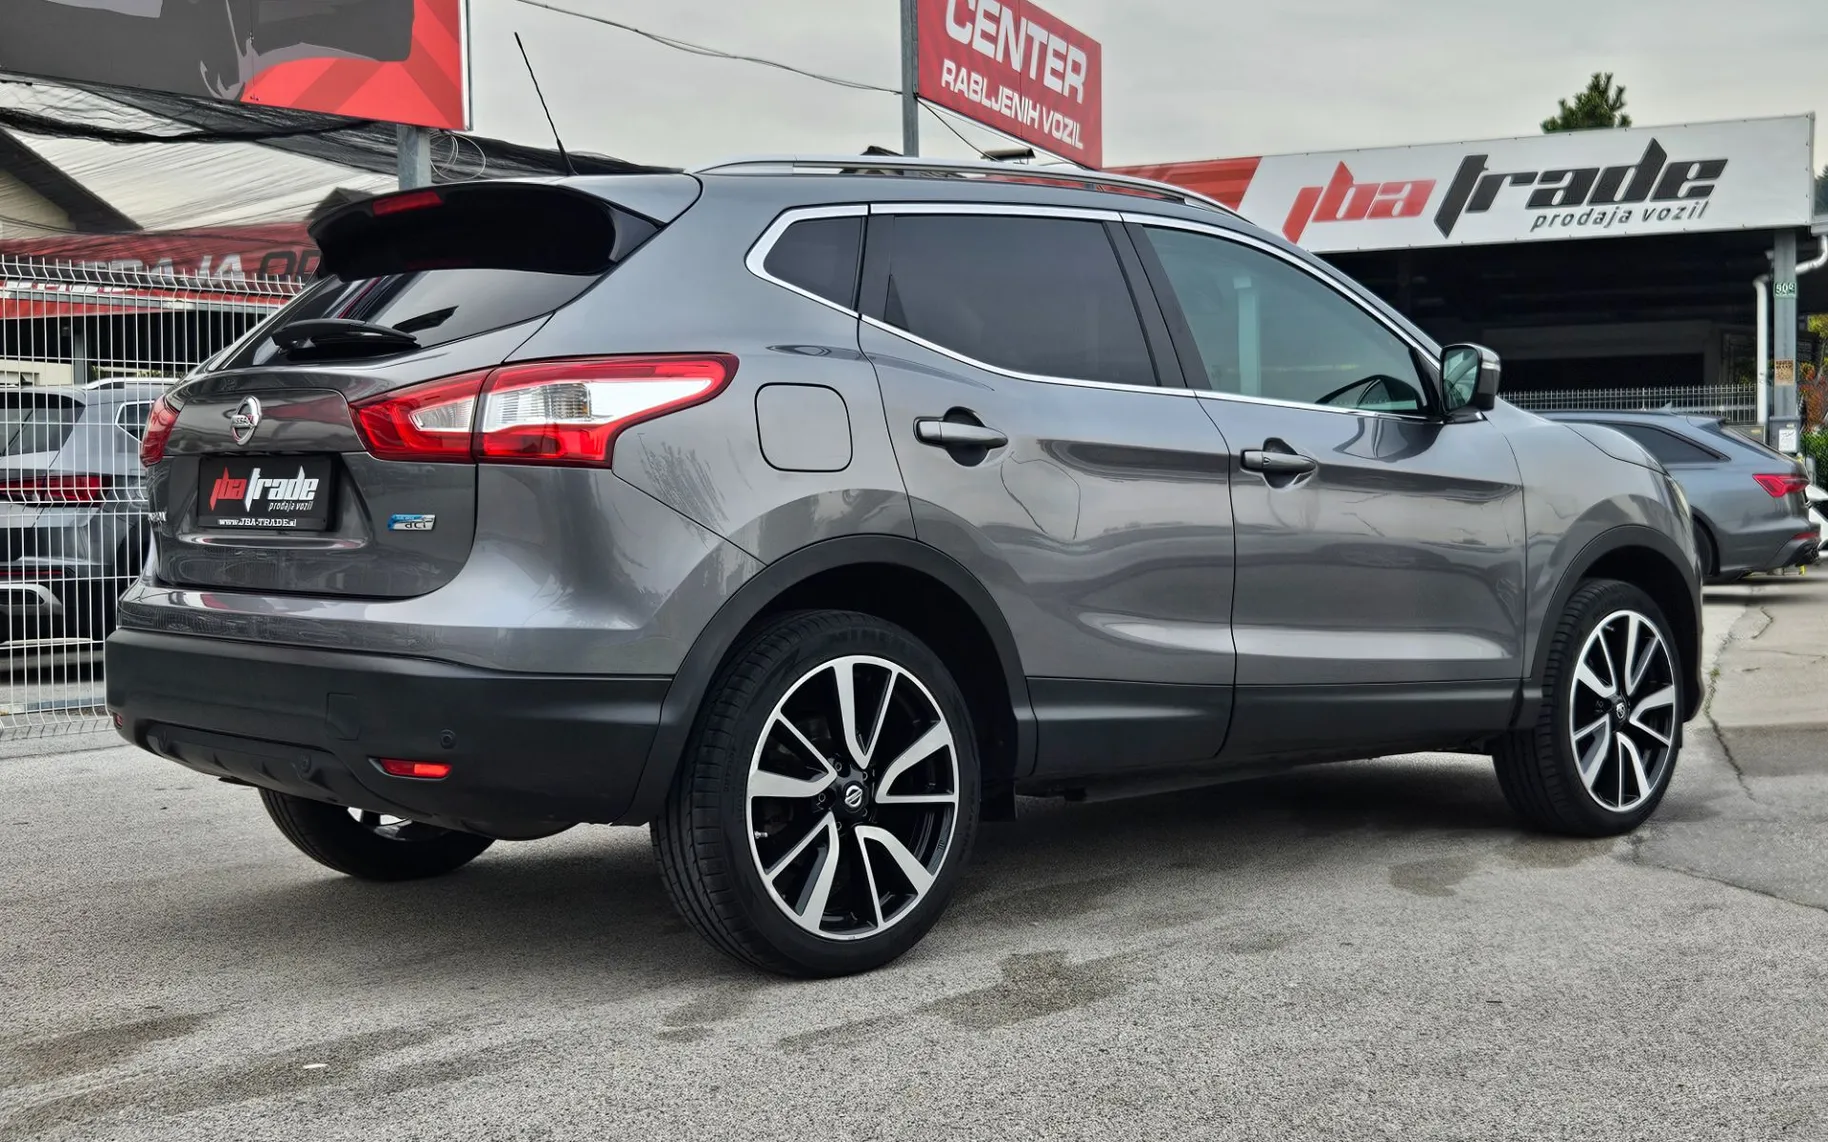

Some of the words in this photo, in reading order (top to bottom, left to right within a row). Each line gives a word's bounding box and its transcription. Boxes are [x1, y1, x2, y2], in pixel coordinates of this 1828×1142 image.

[945, 0, 1087, 104] CENTER
[942, 58, 1040, 130] RABLJENIH
[1043, 107, 1083, 149] VOZIL
[1530, 205, 1633, 232] prodaja
[1641, 200, 1709, 222] vozil
[268, 501, 295, 512] prodaja
[296, 501, 314, 511] vozil
